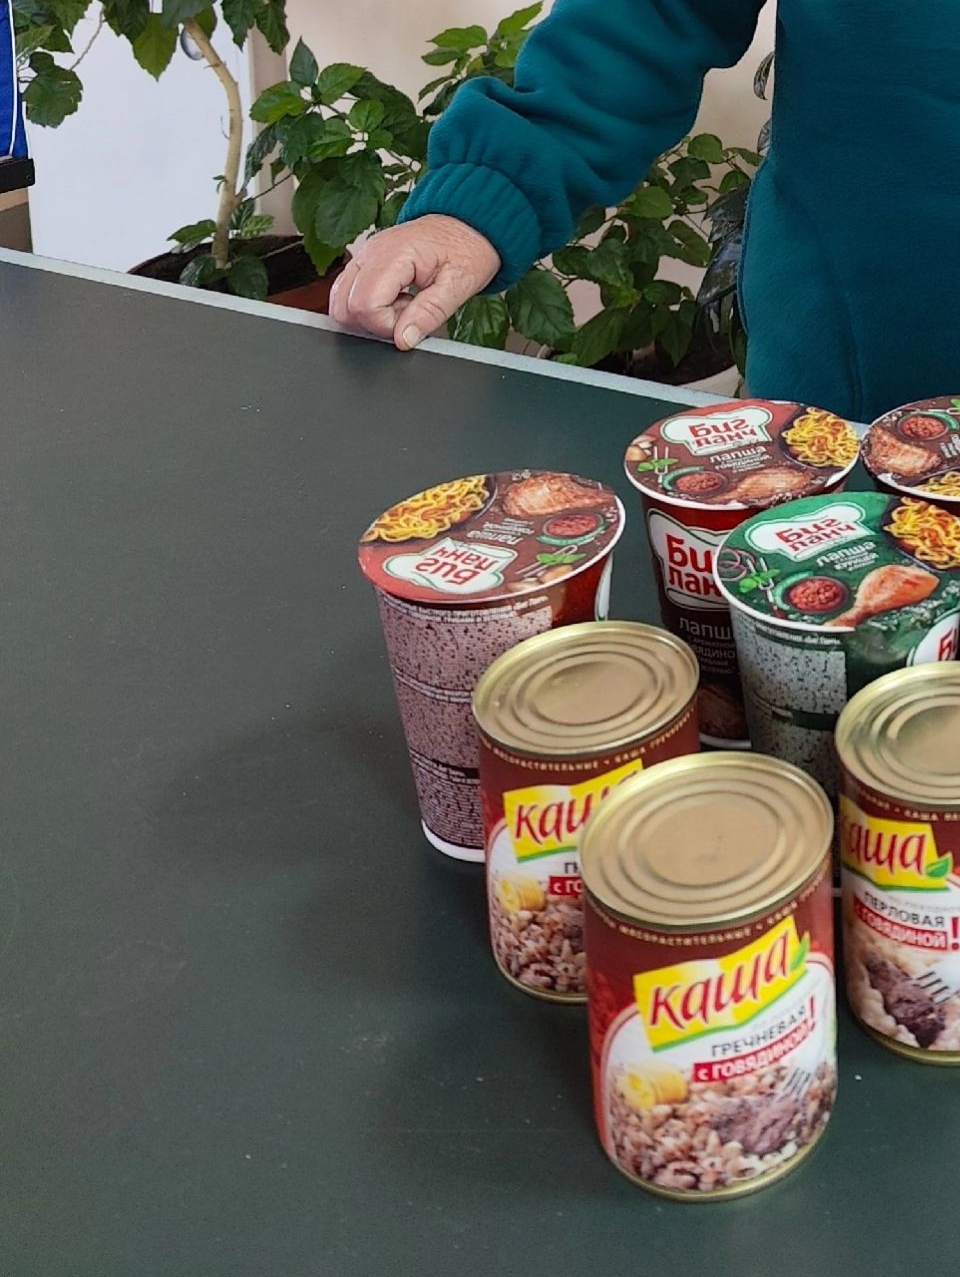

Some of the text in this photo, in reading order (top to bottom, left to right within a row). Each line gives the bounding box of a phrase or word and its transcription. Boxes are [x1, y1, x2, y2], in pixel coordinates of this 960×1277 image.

[688, 418, 747, 438] Биг
[693, 428, 758, 447] ланч
[710, 445, 767, 463] лапша
[776, 518, 838, 543] Биг
[789, 523, 856, 552] ланч
[435, 547, 500, 571] ланч
[666, 533, 714, 573] Би
[816, 541, 877, 567] лапша
[416, 557, 480, 585] Биг
[668, 565, 723, 597] лан
[680, 617, 731, 640] лапш
[516, 786, 612, 845] каш
[905, 809, 938, 822] КАША
[849, 824, 926, 876] аша
[865, 891, 945, 927] ПЕРЛОВАЯ
[711, 1005, 805, 1057] ГРЕЧНЕВАЯ
[697, 1067, 710, 1081] с
